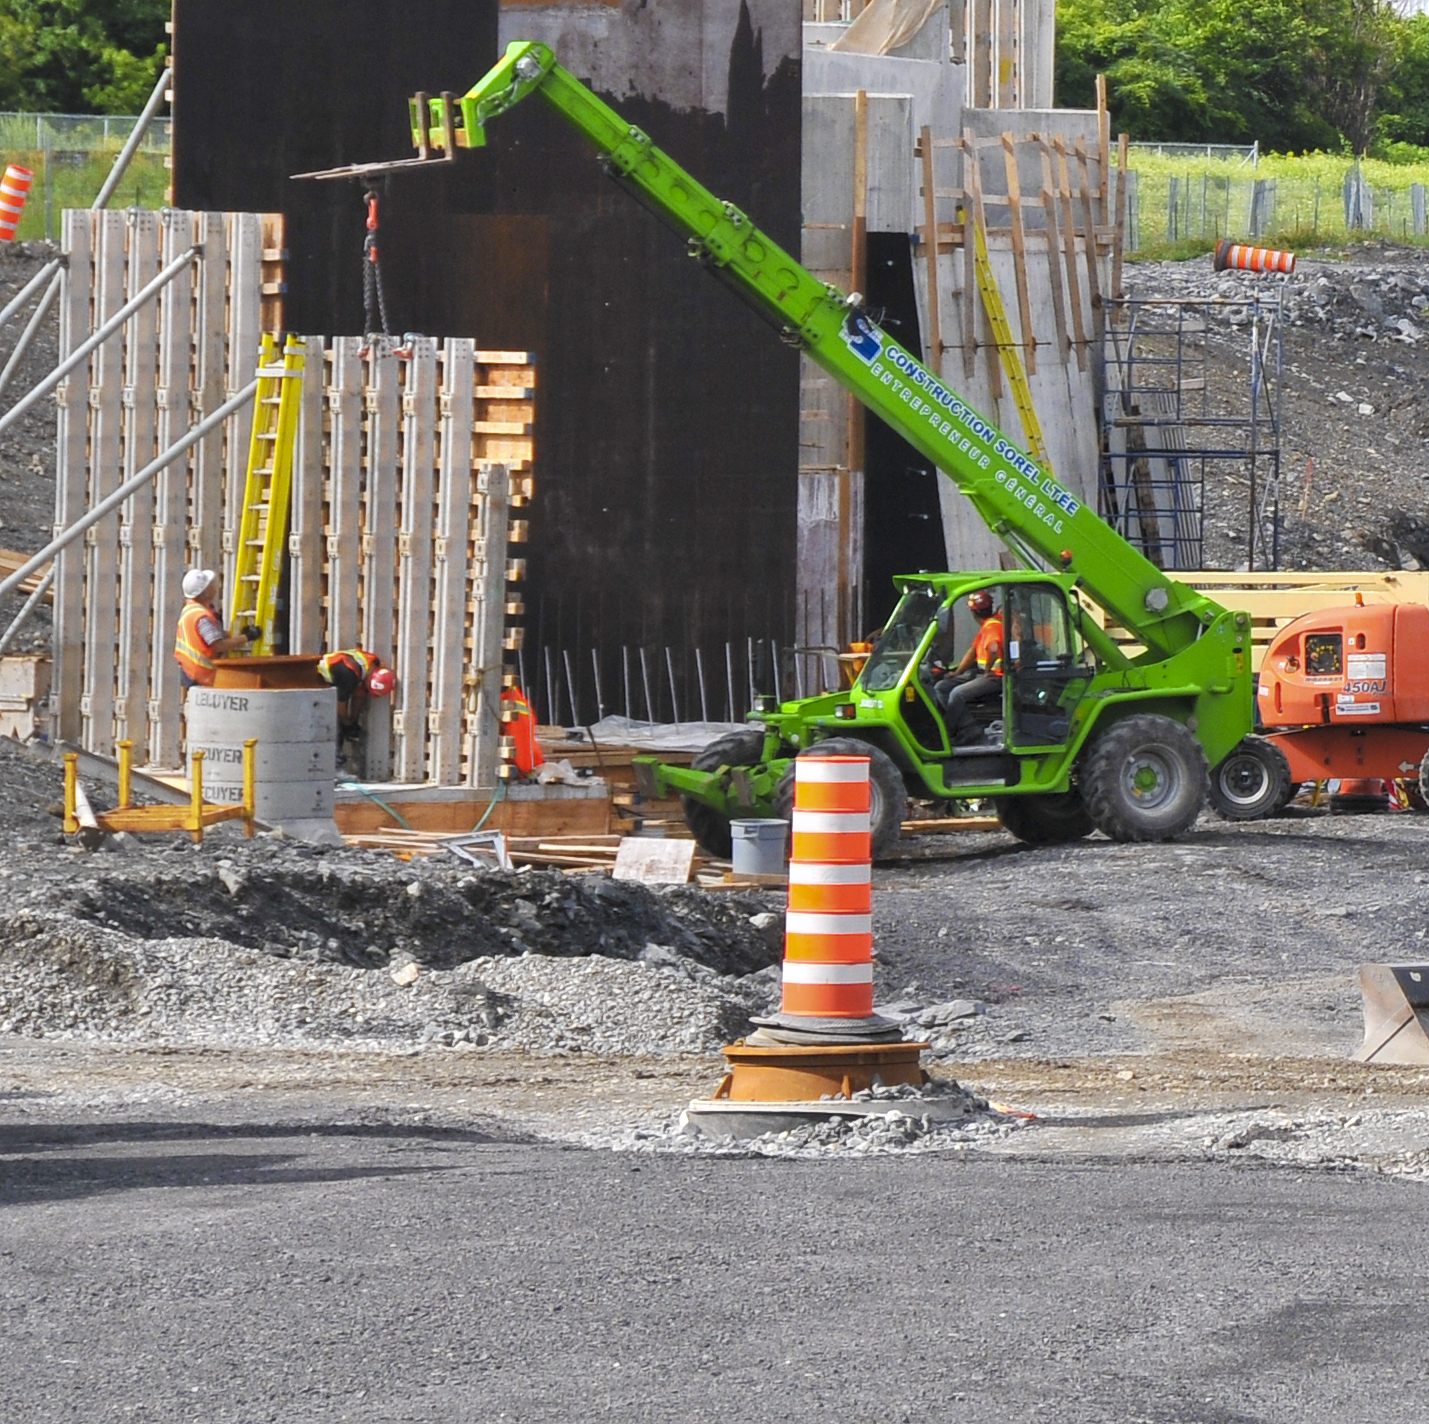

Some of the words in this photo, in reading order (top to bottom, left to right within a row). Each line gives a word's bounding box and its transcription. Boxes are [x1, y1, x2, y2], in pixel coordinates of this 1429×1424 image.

[870, 362, 991, 469] ENTREPRENEUR
[995, 469, 1064, 534] GÉNÉRAL
[885, 344, 996, 445] CONSTRUCTION
[995, 438, 1041, 485] SOREL
[1040, 478, 1080, 517] LTÉE
[1343, 681, 1387, 694] 450AJ
